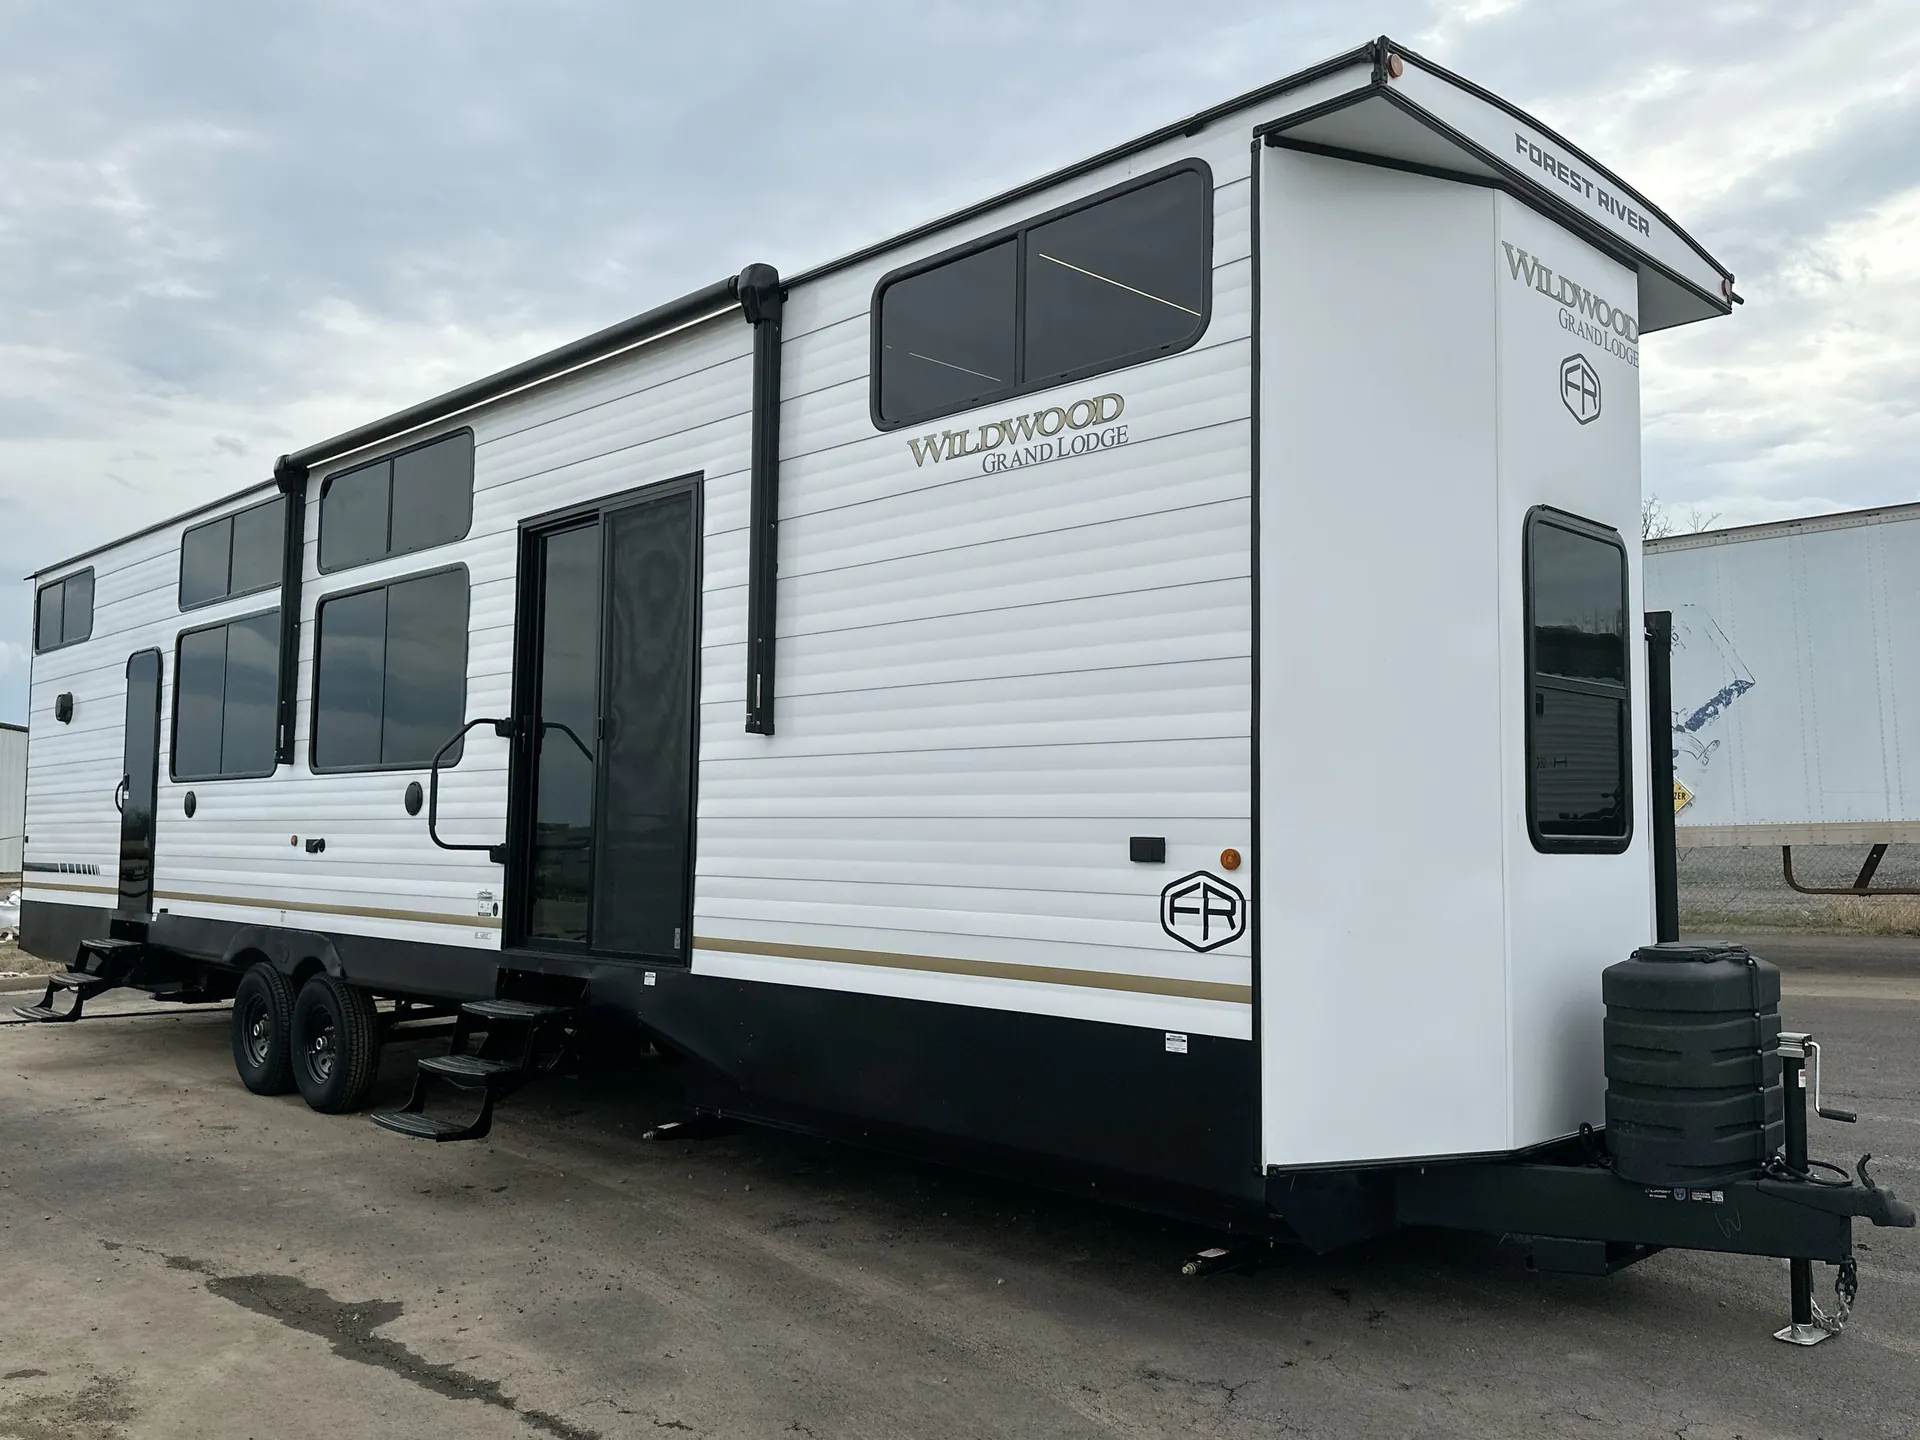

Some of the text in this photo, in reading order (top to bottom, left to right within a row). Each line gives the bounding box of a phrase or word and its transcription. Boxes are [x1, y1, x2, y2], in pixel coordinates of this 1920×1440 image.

[1514, 132, 1651, 238] FOREST RIVER
[1502, 240, 1639, 345] WILDWOOD
[1558, 307, 1639, 368] GRAND LODGE
[1564, 363, 1598, 416] FR
[906, 392, 1125, 468] WILDWOOD
[982, 424, 1130, 474] GRAND LODGE
[1170, 881, 1236, 941] FR
